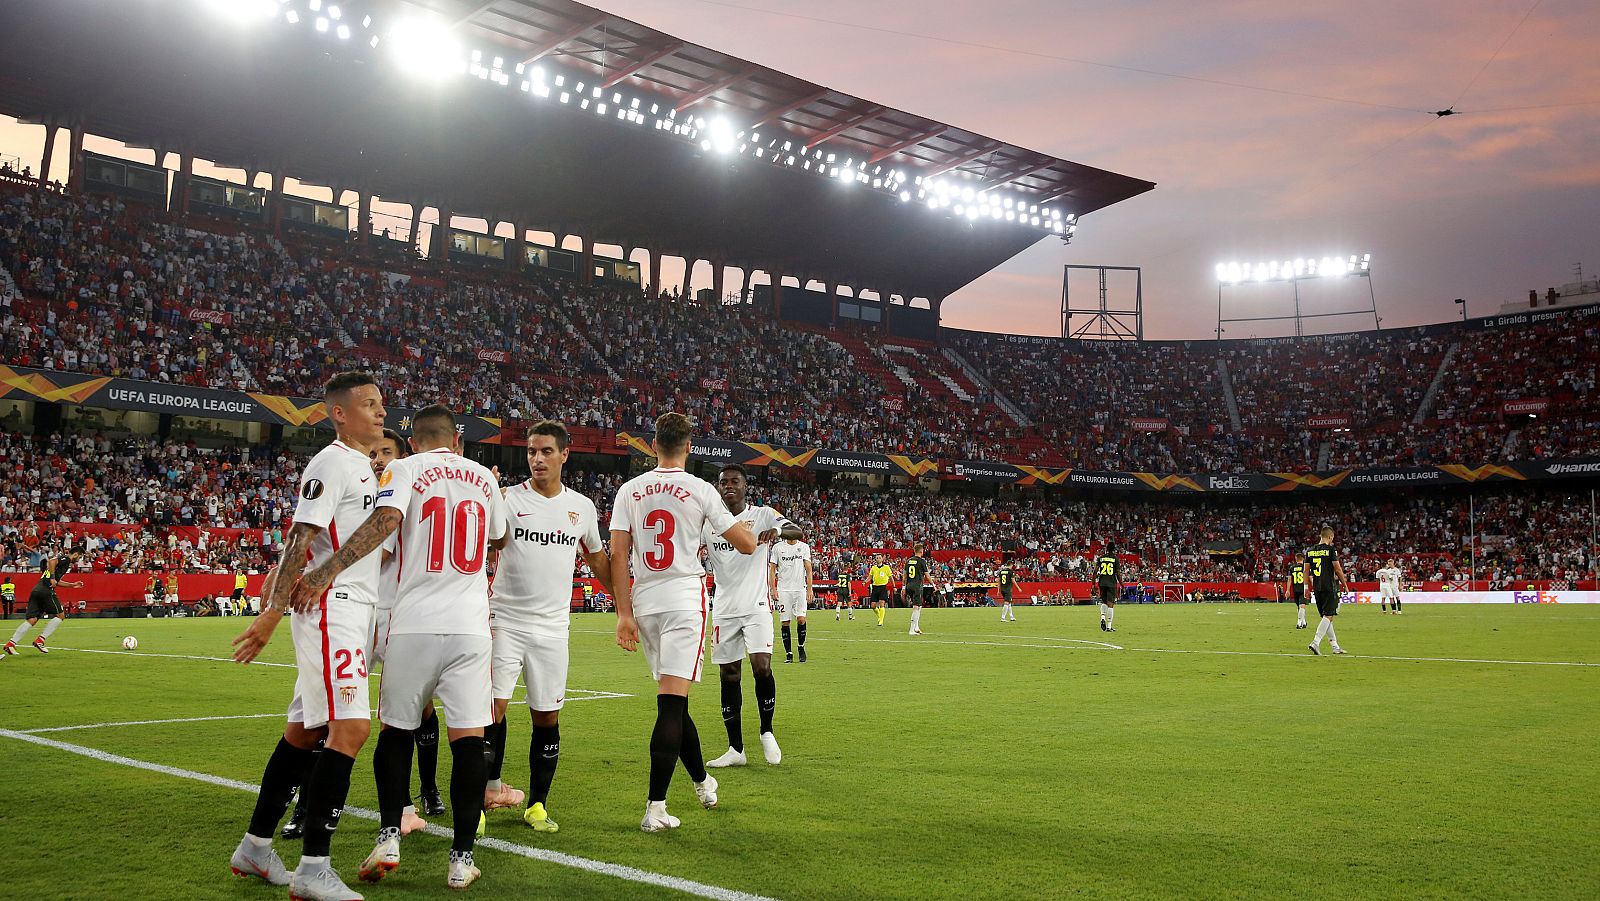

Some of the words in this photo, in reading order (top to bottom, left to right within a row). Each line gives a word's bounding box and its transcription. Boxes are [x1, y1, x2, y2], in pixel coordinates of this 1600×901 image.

[1484, 319, 1494, 327] La
[1498, 314, 1527, 326] Giralda
[109, 388, 145, 404] UEFA
[149, 393, 200, 410] EUROPA
[203, 398, 252, 414] LEAGUE
[1504, 402, 1548, 411] Cruzcampo
[1131, 420, 1167, 430] Cruzcampo
[1308, 417, 1348, 426] Cruzcampo
[712, 447, 732, 458] GAME
[816, 456, 836, 466] UEFA
[837, 457, 863, 468] EUROPA
[863, 460, 890, 470] LEAGUE
[1071, 474, 1086, 483] UEFA
[1086, 475, 1109, 484] EUROPA
[1109, 477, 1134, 485] LEAGUE
[1209, 476, 1249, 489] FedEx
[1350, 474, 1372, 483] UEFA
[1373, 472, 1406, 482] EUROPA
[1406, 470, 1439, 480] LEAGUE
[419, 495, 486, 575] 10
[514, 527, 577, 547] Playtika
[643, 508, 676, 572] 3
[712, 542, 735, 552] Play
[908, 565, 916, 579] 9
[1100, 562, 1114, 576] 26
[1313, 557, 1322, 577] 3
[1292, 571, 1304, 584] 18
[1340, 592, 1372, 604] edEx
[1514, 591, 1559, 604] FedEx
[334, 648, 368, 680] 23
[544, 743, 559, 751] SFC
[332, 808, 343, 818] SF
